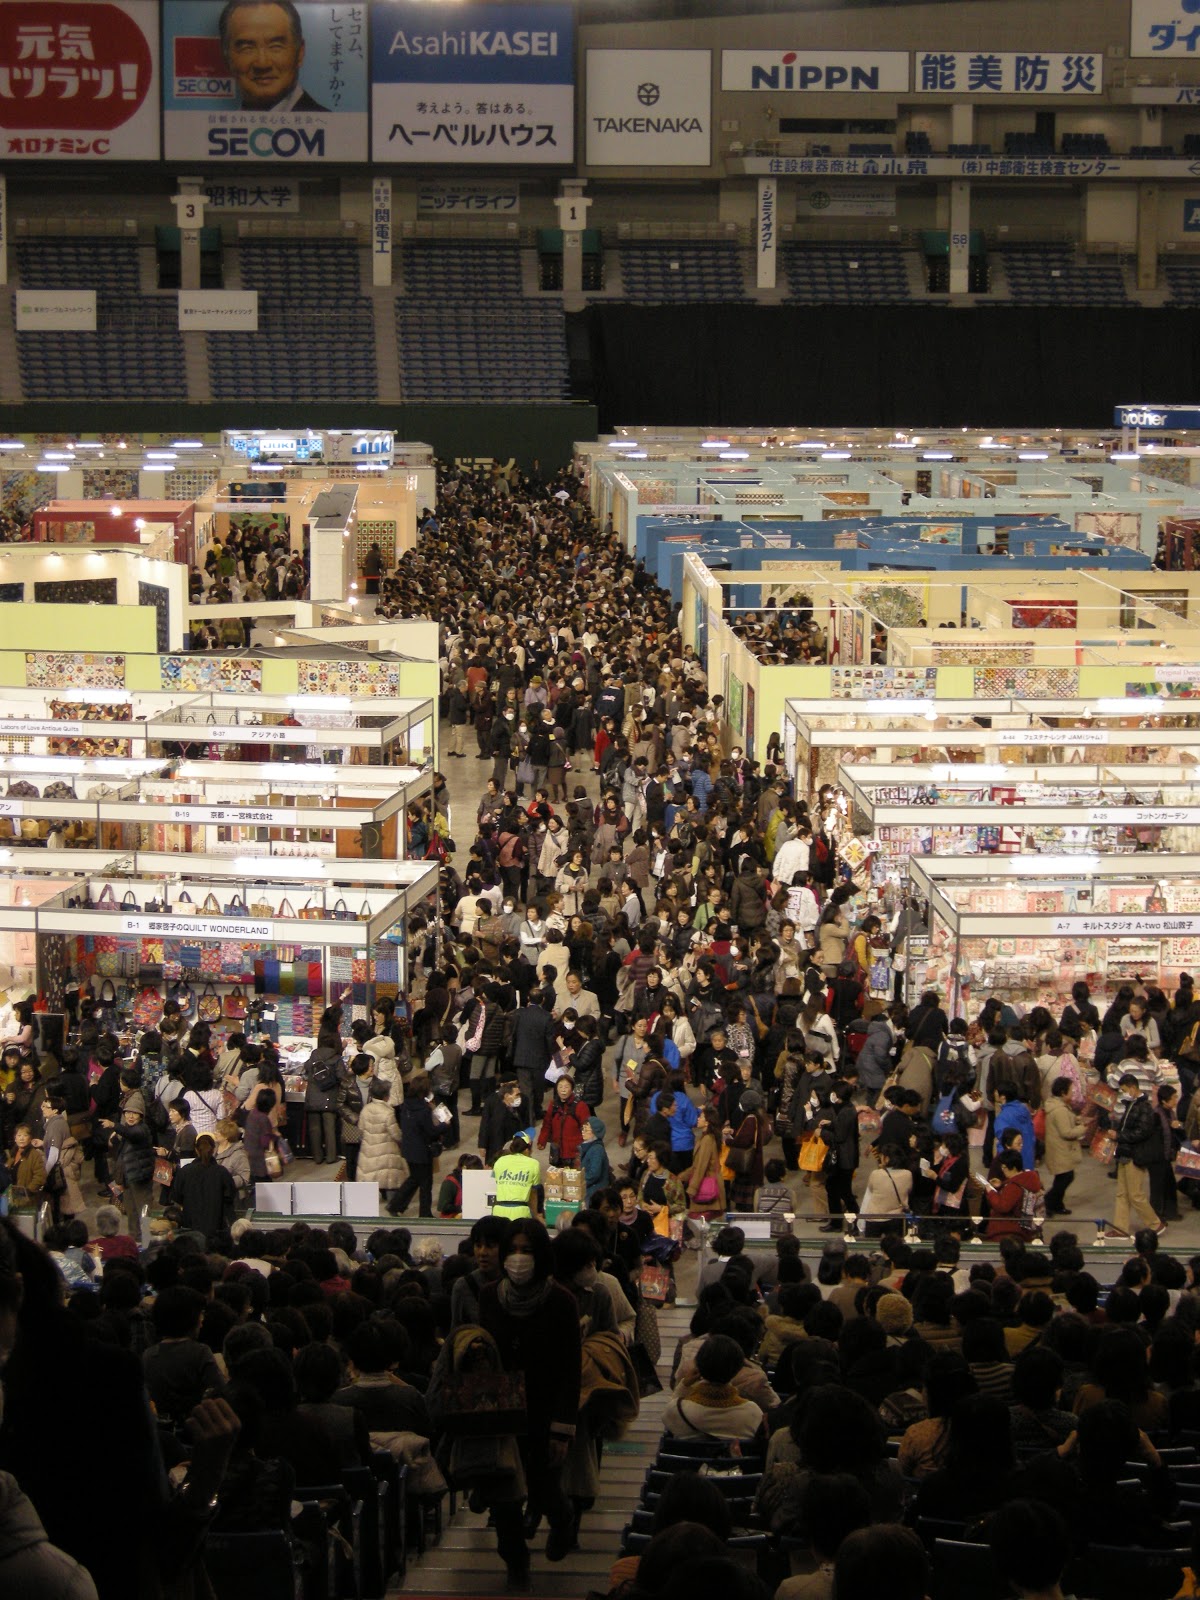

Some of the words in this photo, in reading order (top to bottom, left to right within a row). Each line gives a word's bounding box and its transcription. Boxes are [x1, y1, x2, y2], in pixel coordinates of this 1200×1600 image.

[348, 7, 363, 59] セコム、
[16, 24, 95, 60] 元気
[921, 53, 1097, 93] 能美防災
[177, 79, 232, 93] SECOM
[593, 117, 703, 133] TAKENAKA
[208, 127, 325, 157] SECOM
[388, 124, 558, 146] ヘーベルハウス
[7, 138, 110, 154] オロナミンC
[768, 159, 860, 173] 住設機器商社
[883, 159, 928, 175] 小泉
[205, 185, 291, 207] 昭和大学
[420, 195, 517, 209] ニッテイライフ
[186, 204, 196, 218] 3
[570, 207, 577, 220] 1
[761, 190, 774, 252] シミズオクト
[375, 208, 390, 253] 関電工
[952, 234, 968, 245] 58
[1121, 410, 1168, 426] brother
[352, 437, 393, 455] JUKI
[1157, 669, 1181, 677] Original
[210, 811, 274, 821] 京都・一宮株式会社
[1136, 812, 1189, 821] コットンガーデン
[127, 921, 140, 929] B-1
[209, 924, 269, 935] WONDERLAND
[1056, 922, 1071, 930] A-7
[1082, 921, 1133, 930] キルトスタジオ
[1135, 921, 1161, 930] A-two
[1162, 920, 1194, 930] 松山敦子
[499, 1168, 530, 1183] Asahi
